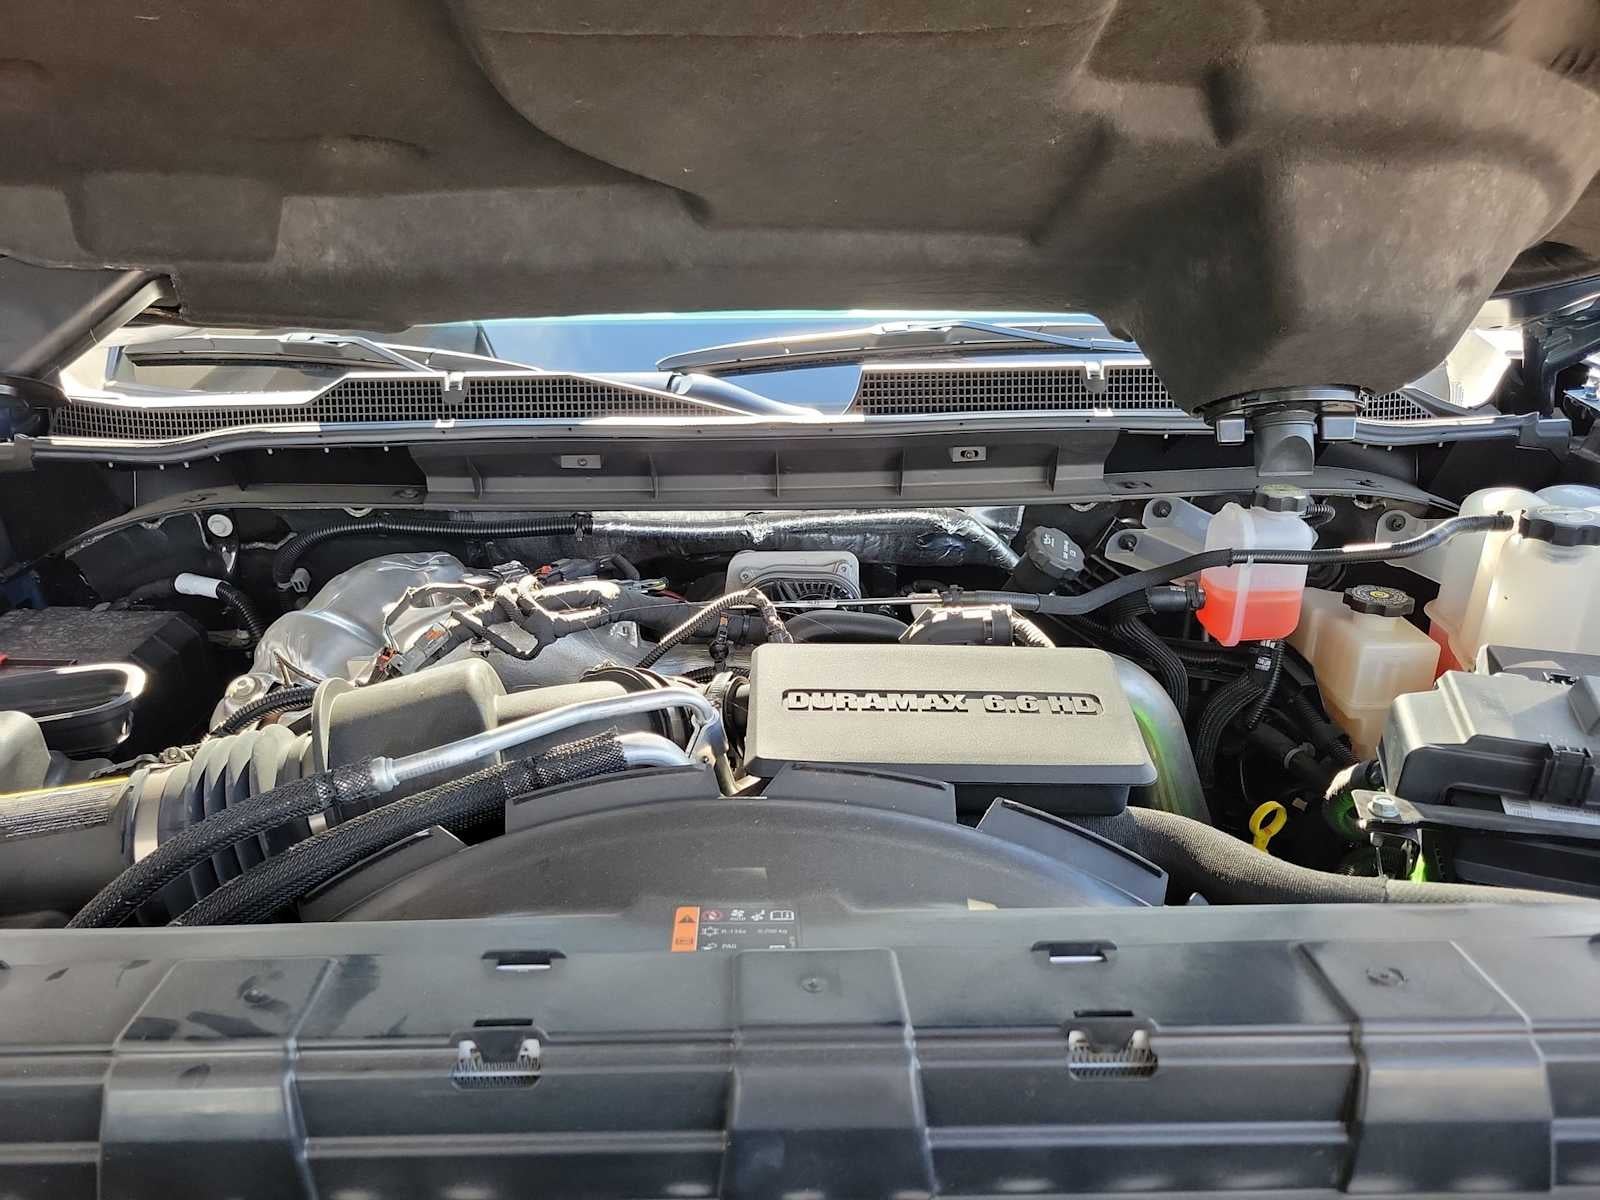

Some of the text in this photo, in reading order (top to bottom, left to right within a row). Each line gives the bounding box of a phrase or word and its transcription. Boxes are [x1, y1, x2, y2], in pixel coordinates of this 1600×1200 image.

[786, 691, 1098, 715] DURAMAX 6.6 HD
